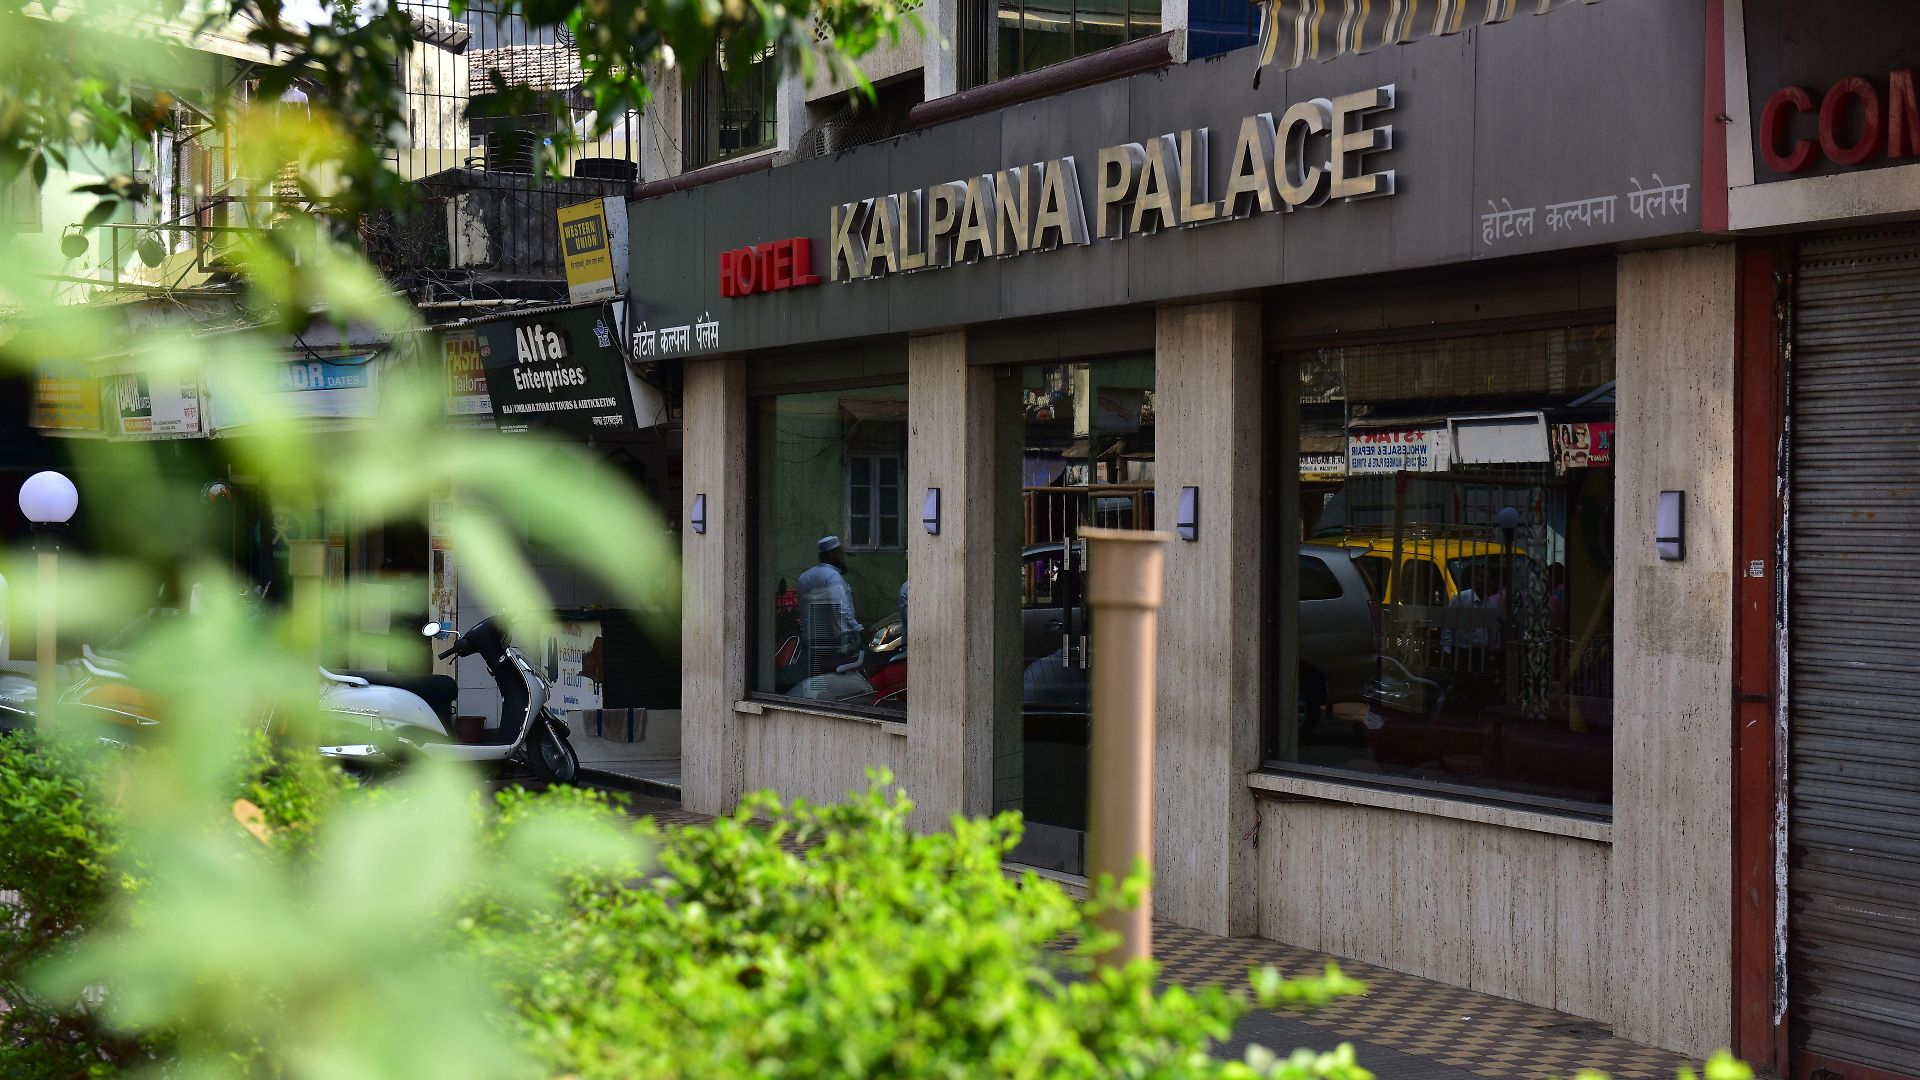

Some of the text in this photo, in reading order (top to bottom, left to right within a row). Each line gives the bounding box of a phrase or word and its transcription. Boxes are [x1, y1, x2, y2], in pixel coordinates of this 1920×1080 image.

[719, 84, 1395, 298] HOTEL KALPANA PALACE
[1481, 173, 1690, 245] होटेल कल्पना पेलेस
[564, 220, 595, 239] WESTERN
[575, 233, 599, 250] UNION
[515, 324, 563, 363] Alfa
[660, 325, 690, 354] कल्पना
[327, 375, 359, 386] DATES
[453, 373, 477, 392] Tailor
[513, 363, 585, 394] Enterprises
[563, 669, 582, 688] Tailor
